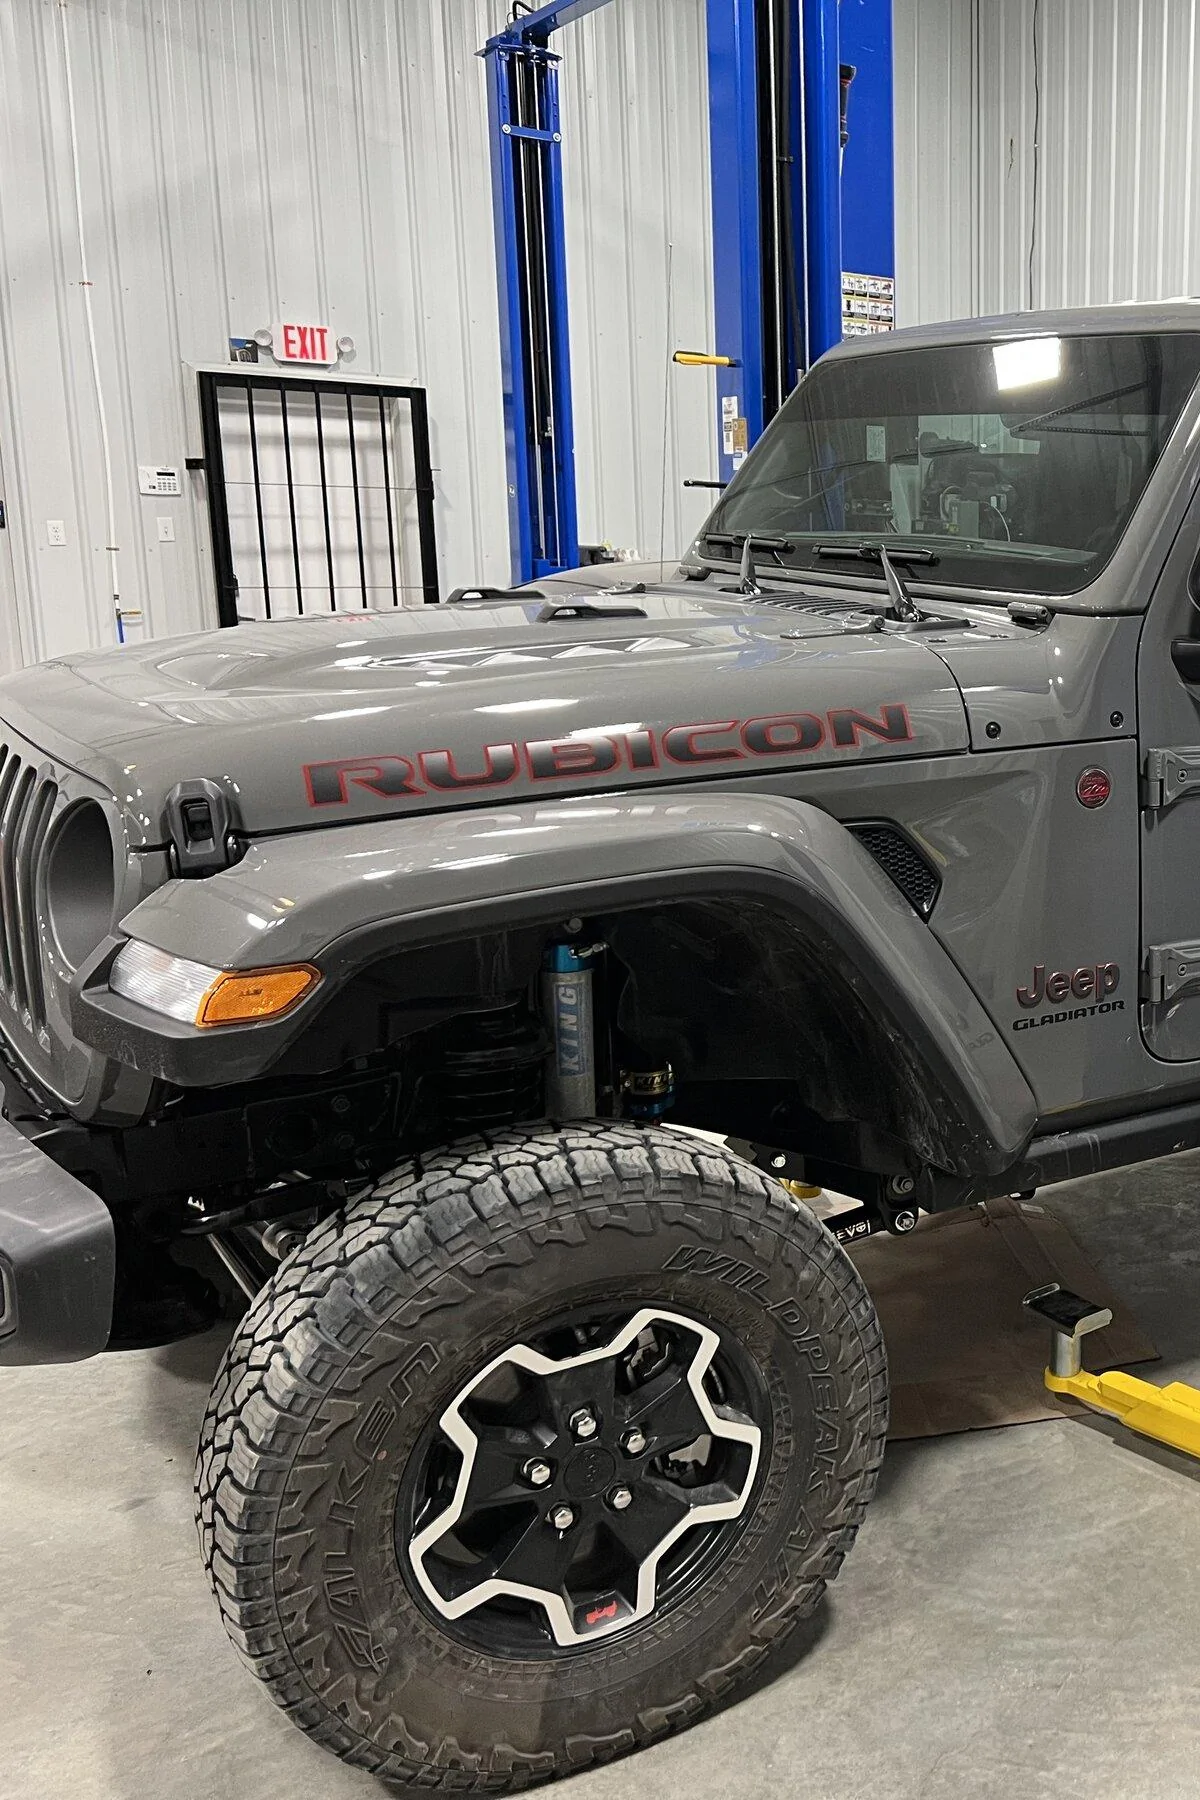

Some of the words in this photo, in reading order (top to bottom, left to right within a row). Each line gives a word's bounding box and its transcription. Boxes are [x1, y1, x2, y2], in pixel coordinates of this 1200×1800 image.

[283, 325, 328, 361] EXIT
[302, 703, 913, 807] RUBICON
[558, 986, 581, 1072] KING
[1012, 1000, 1126, 1031] GLADIATOR
[1016, 963, 1120, 1009] Jeep
[660, 1244, 841, 1497] WILDPEAK
[324, 1342, 441, 1678] FALKEN
